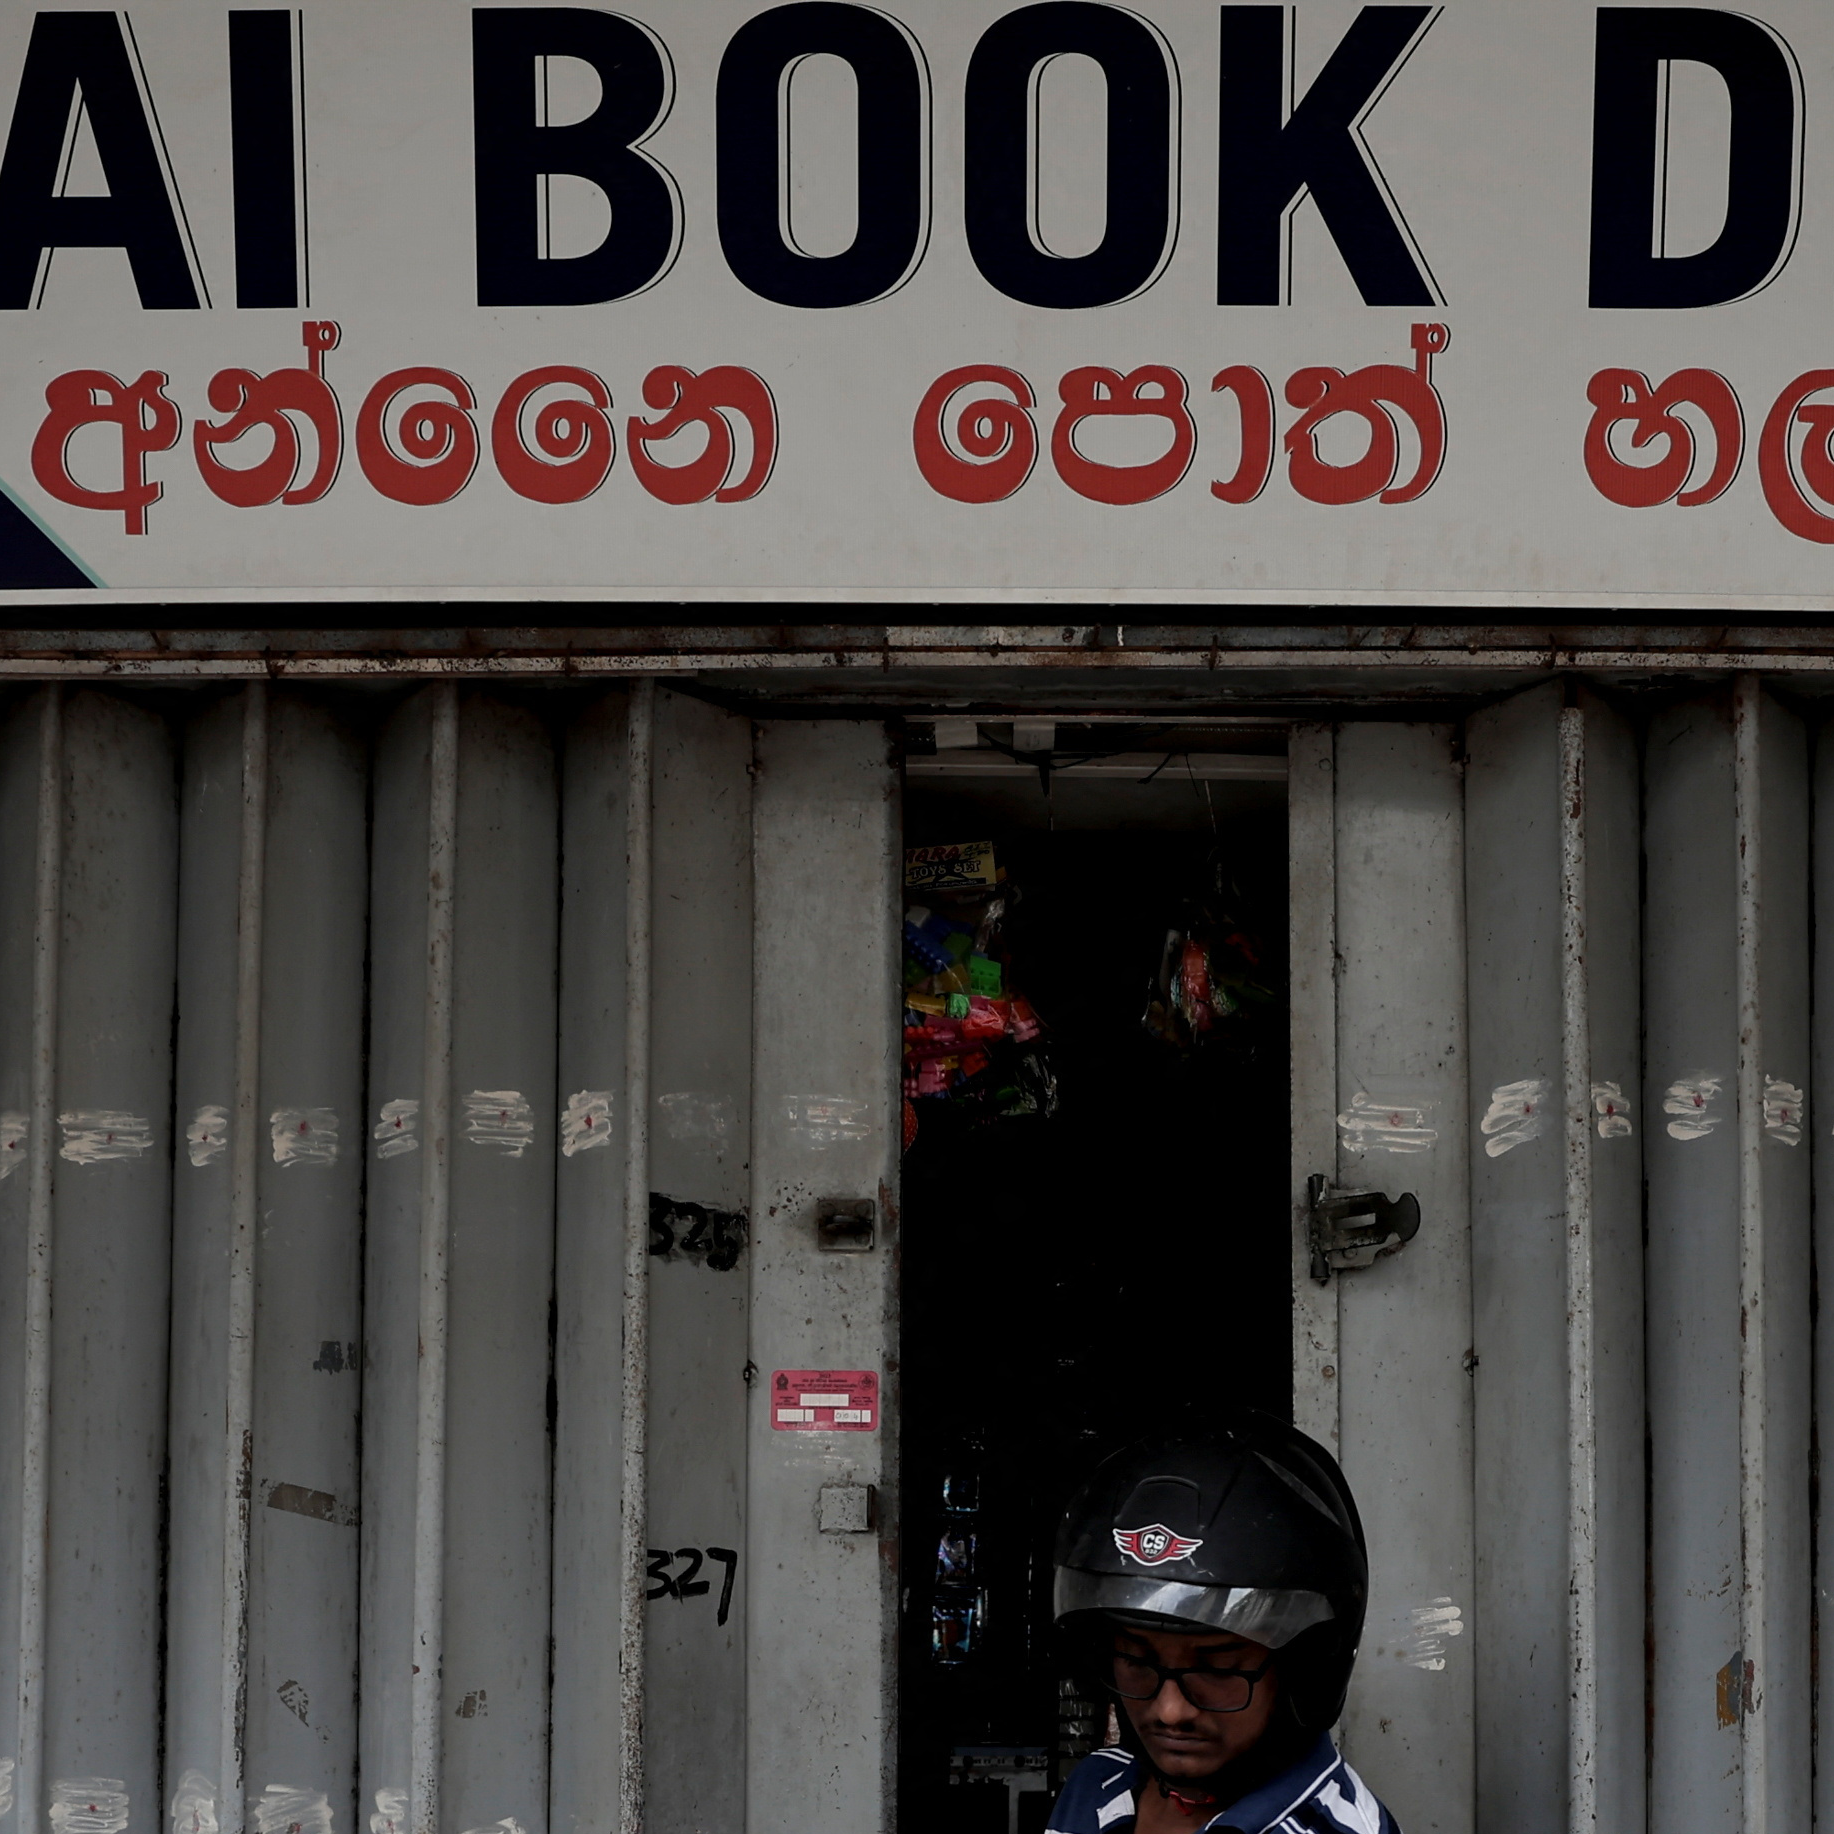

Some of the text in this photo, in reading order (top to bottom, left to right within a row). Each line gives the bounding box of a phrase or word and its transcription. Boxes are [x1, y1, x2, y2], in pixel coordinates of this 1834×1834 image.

[473, 0, 1449, 310] BOOK
[911, 859, 982, 880] TOYS SET
[1142, 1533, 1166, 1550] CS
